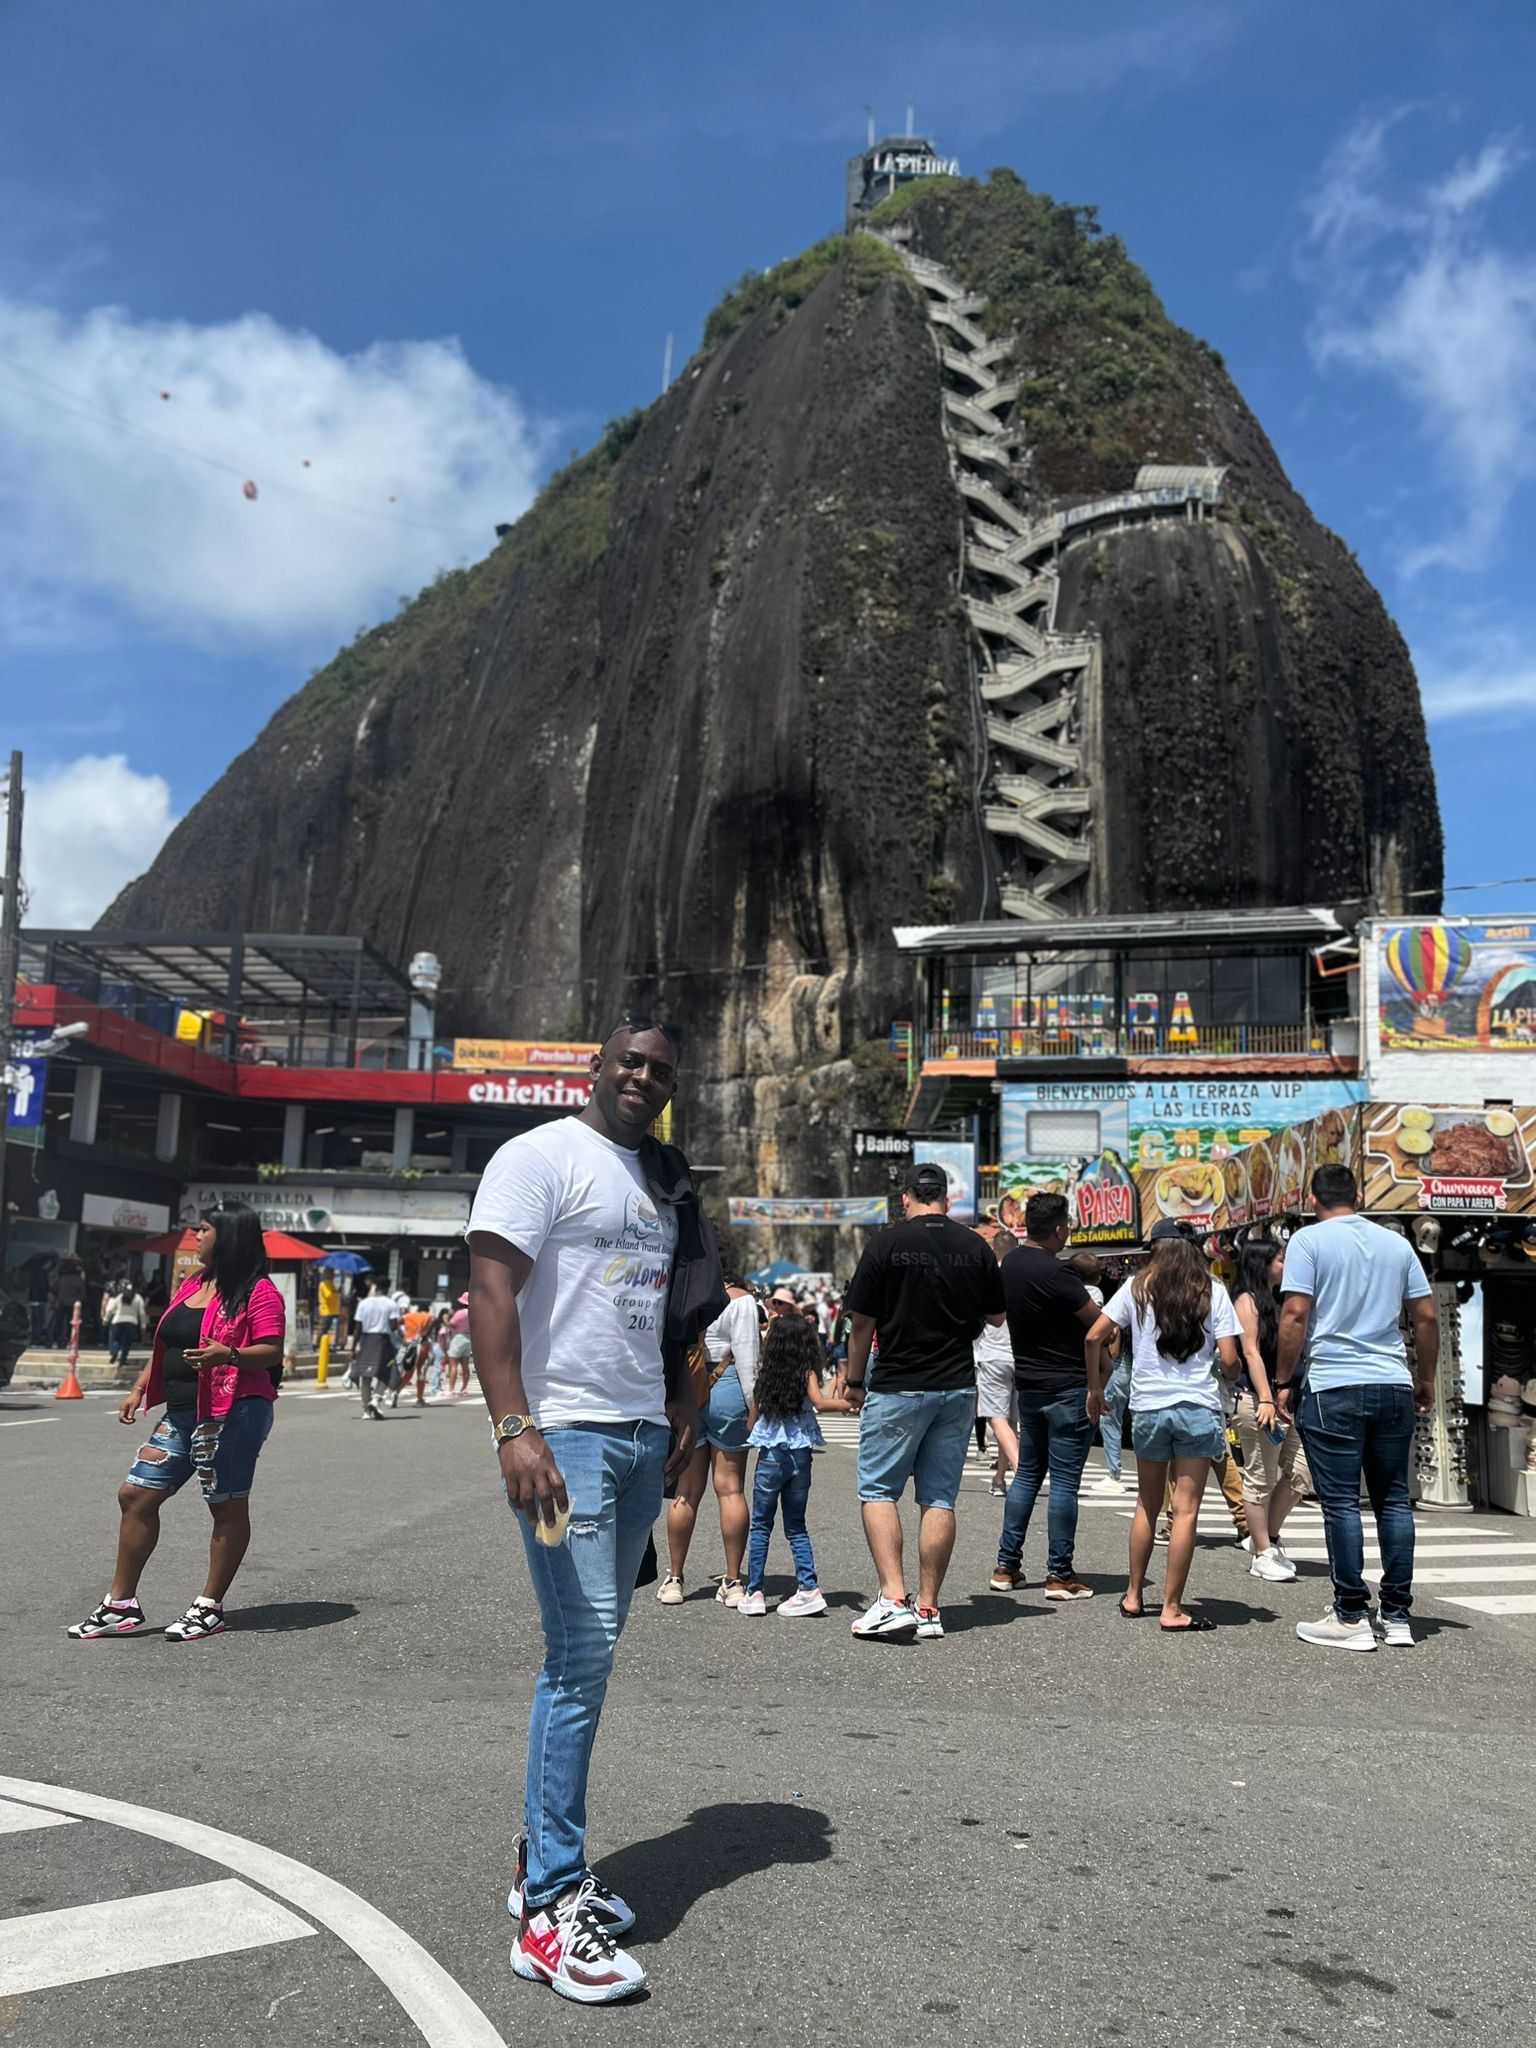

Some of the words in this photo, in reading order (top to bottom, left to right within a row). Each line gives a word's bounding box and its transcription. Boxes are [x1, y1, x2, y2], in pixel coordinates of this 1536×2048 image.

[1515, 1007, 1536, 1026] PI
[468, 1077, 593, 1107] chickin
[1037, 1084, 1136, 1100] BIENVENIDOS
[1146, 1085, 1154, 1099] A
[1161, 1085, 1180, 1099] LA
[1188, 1084, 1260, 1099] TERRAZA
[1271, 1084, 1303, 1099] VIP
[1153, 1102, 1183, 1118] LAS
[1191, 1102, 1251, 1118] LETRAS
[866, 1134, 910, 1152] Baños
[1430, 1179, 1498, 1196] Churrasco
[198, 1191, 217, 1202] LA
[222, 1192, 315, 1206] ESMERALDA
[1432, 1197, 1446, 1208] CON
[1447, 1197, 1464, 1208] PAPA
[1464, 1197, 1471, 1208] Y
[1471, 1197, 1493, 1209] AREPA
[1071, 1228, 1136, 1243] RESTAURANTE
[595, 1236, 612, 1249] The
[615, 1237, 640, 1251] Island
[641, 1241, 660, 1254] Travel
[613, 1294, 651, 1310] Group
